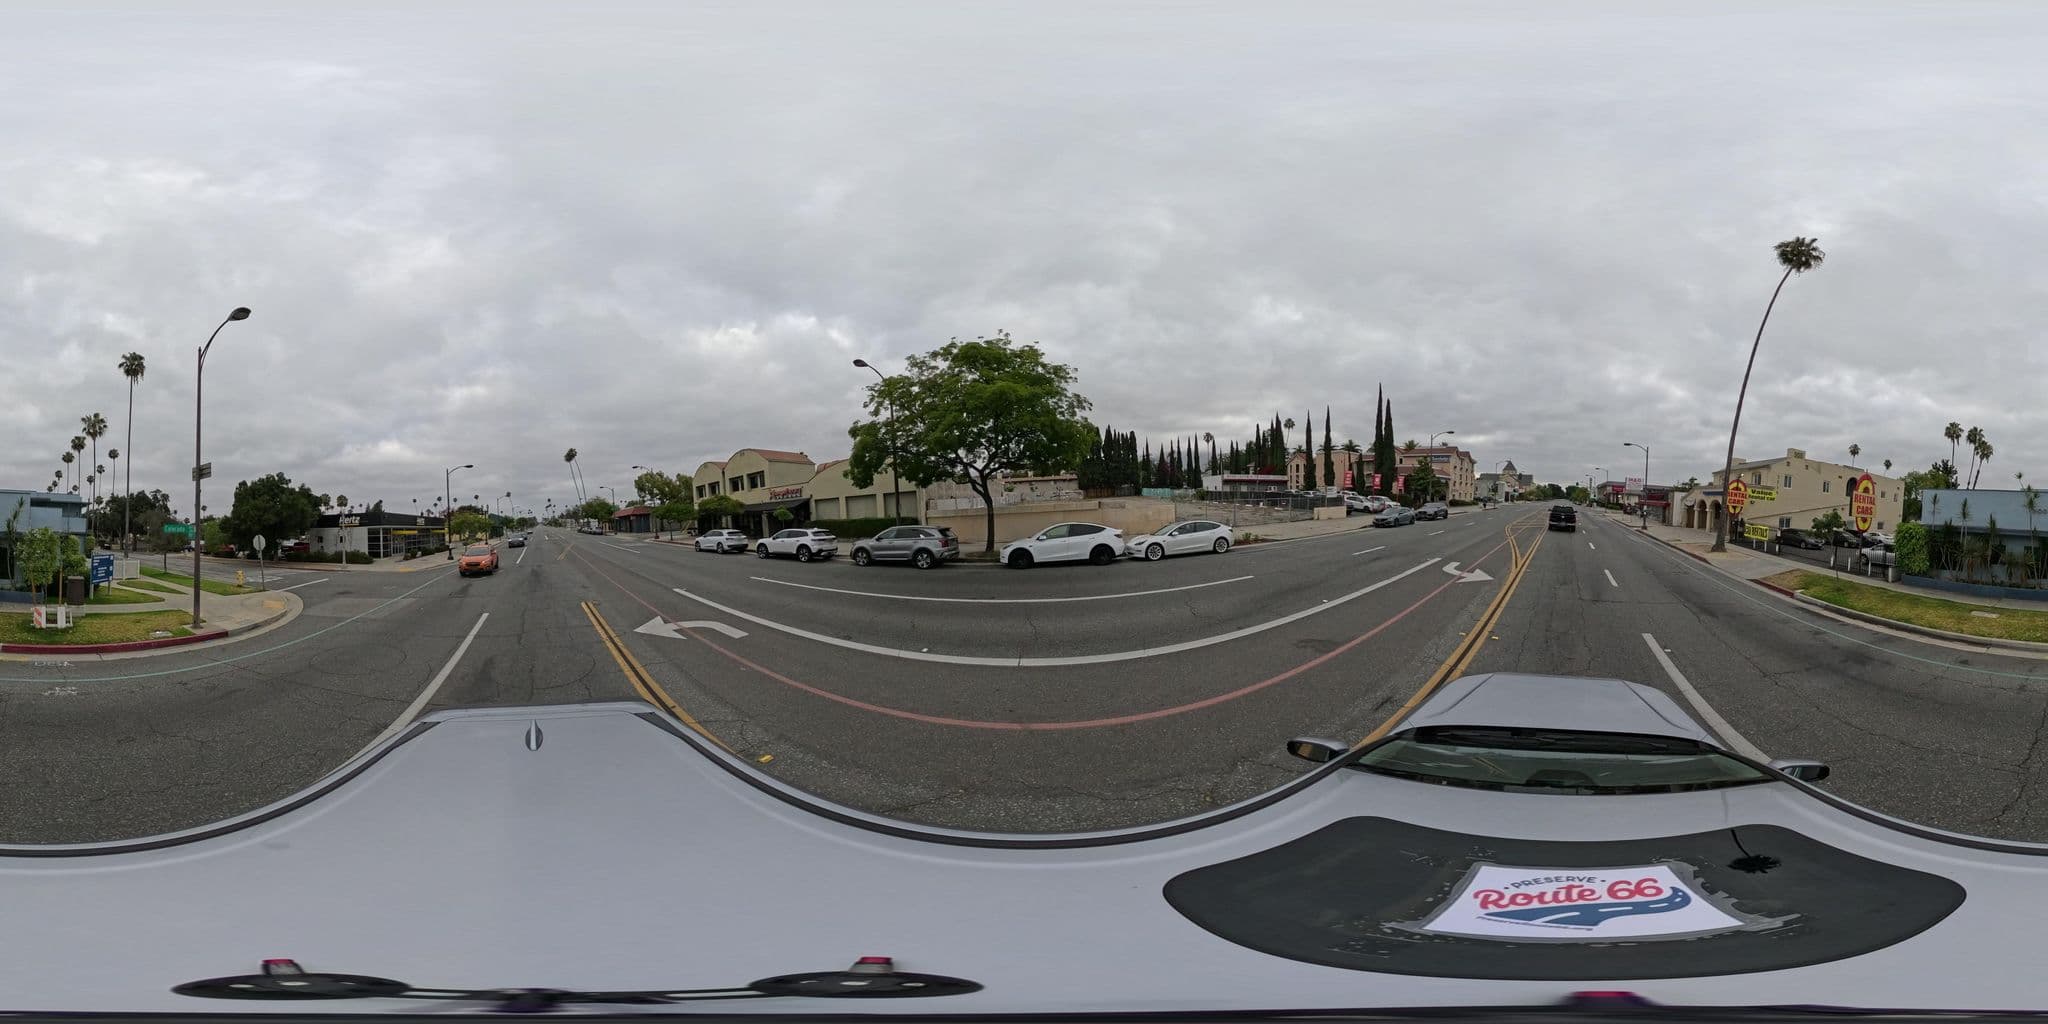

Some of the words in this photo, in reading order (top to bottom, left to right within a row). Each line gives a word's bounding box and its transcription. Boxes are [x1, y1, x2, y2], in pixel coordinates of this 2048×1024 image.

[1854, 493, 1876, 506] RENTAL
[1856, 505, 1873, 515] CARS
[338, 516, 360, 524] Hertz
[1510, 875, 1597, 889] PRESERVE
[1472, 884, 1601, 909] Route
[1606, 877, 1664, 900] 66
